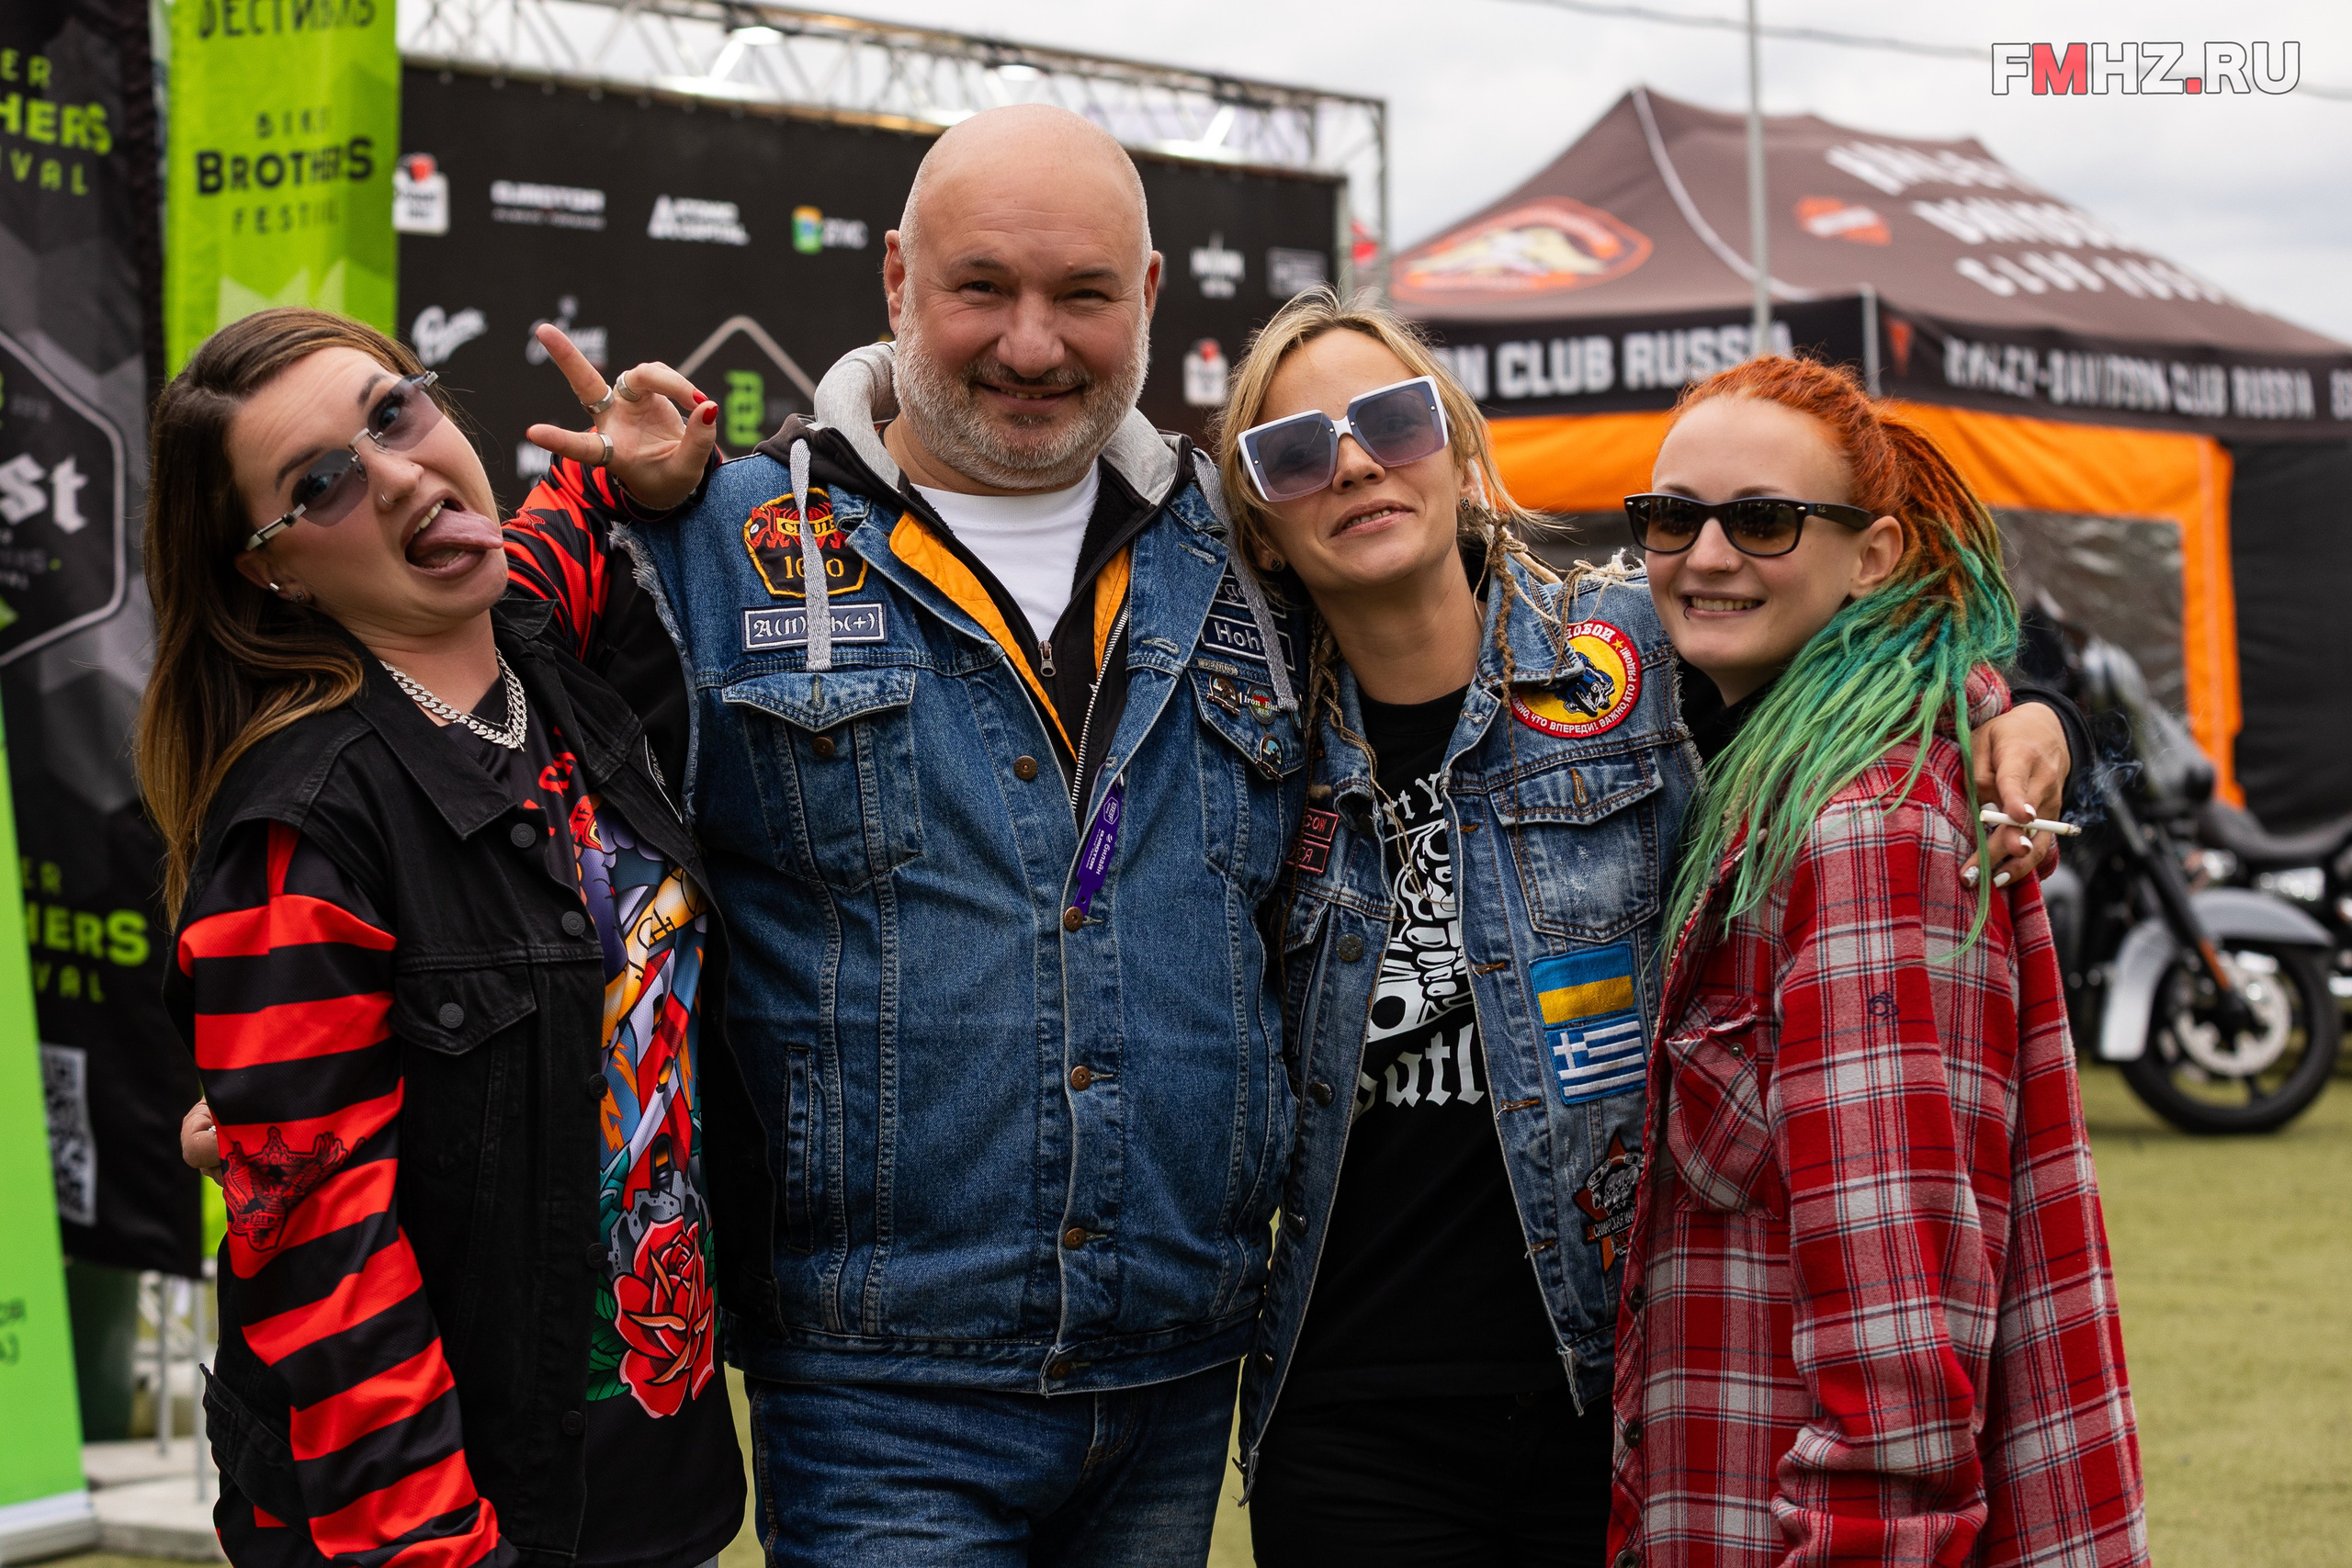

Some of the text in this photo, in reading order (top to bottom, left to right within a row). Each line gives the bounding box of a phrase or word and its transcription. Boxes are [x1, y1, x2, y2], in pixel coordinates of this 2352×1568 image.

[1495, 334, 1616, 400] CLUB
[1244, 695, 1261, 706] Iron
[1531, 713, 1548, 728] ЧТО
[1549, 720, 1600, 735] ВПЕРЕДИ!
[1624, 684, 1636, 704] КТО
[1096, 843, 1112, 875] билайн
